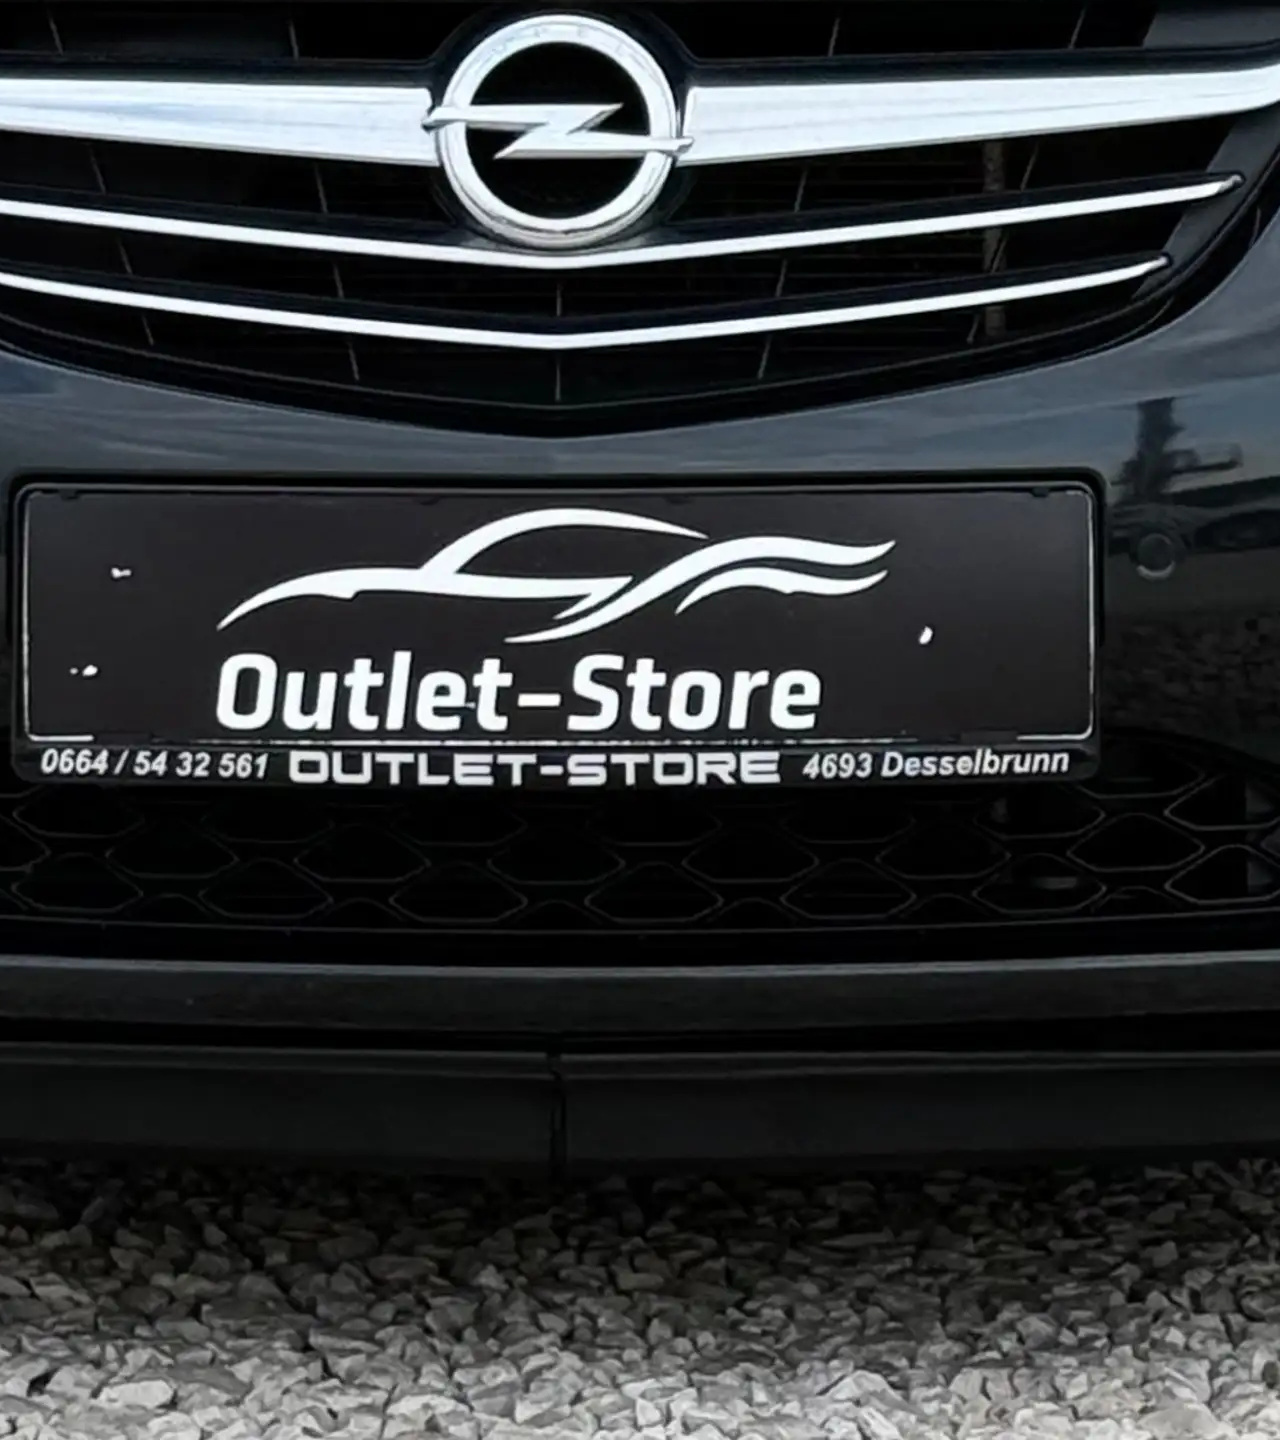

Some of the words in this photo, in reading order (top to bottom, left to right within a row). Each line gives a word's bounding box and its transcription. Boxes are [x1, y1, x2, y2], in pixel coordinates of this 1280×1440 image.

[215, 651, 821, 732] Outlet-Store
[40, 747, 109, 775] 0664
[133, 749, 168, 777] 54
[176, 750, 211, 778] 32
[218, 751, 269, 779] 561
[288, 750, 781, 787] OUTLET-STORE
[801, 750, 872, 780] 4693
[880, 747, 1070, 779] Desselbrunn
